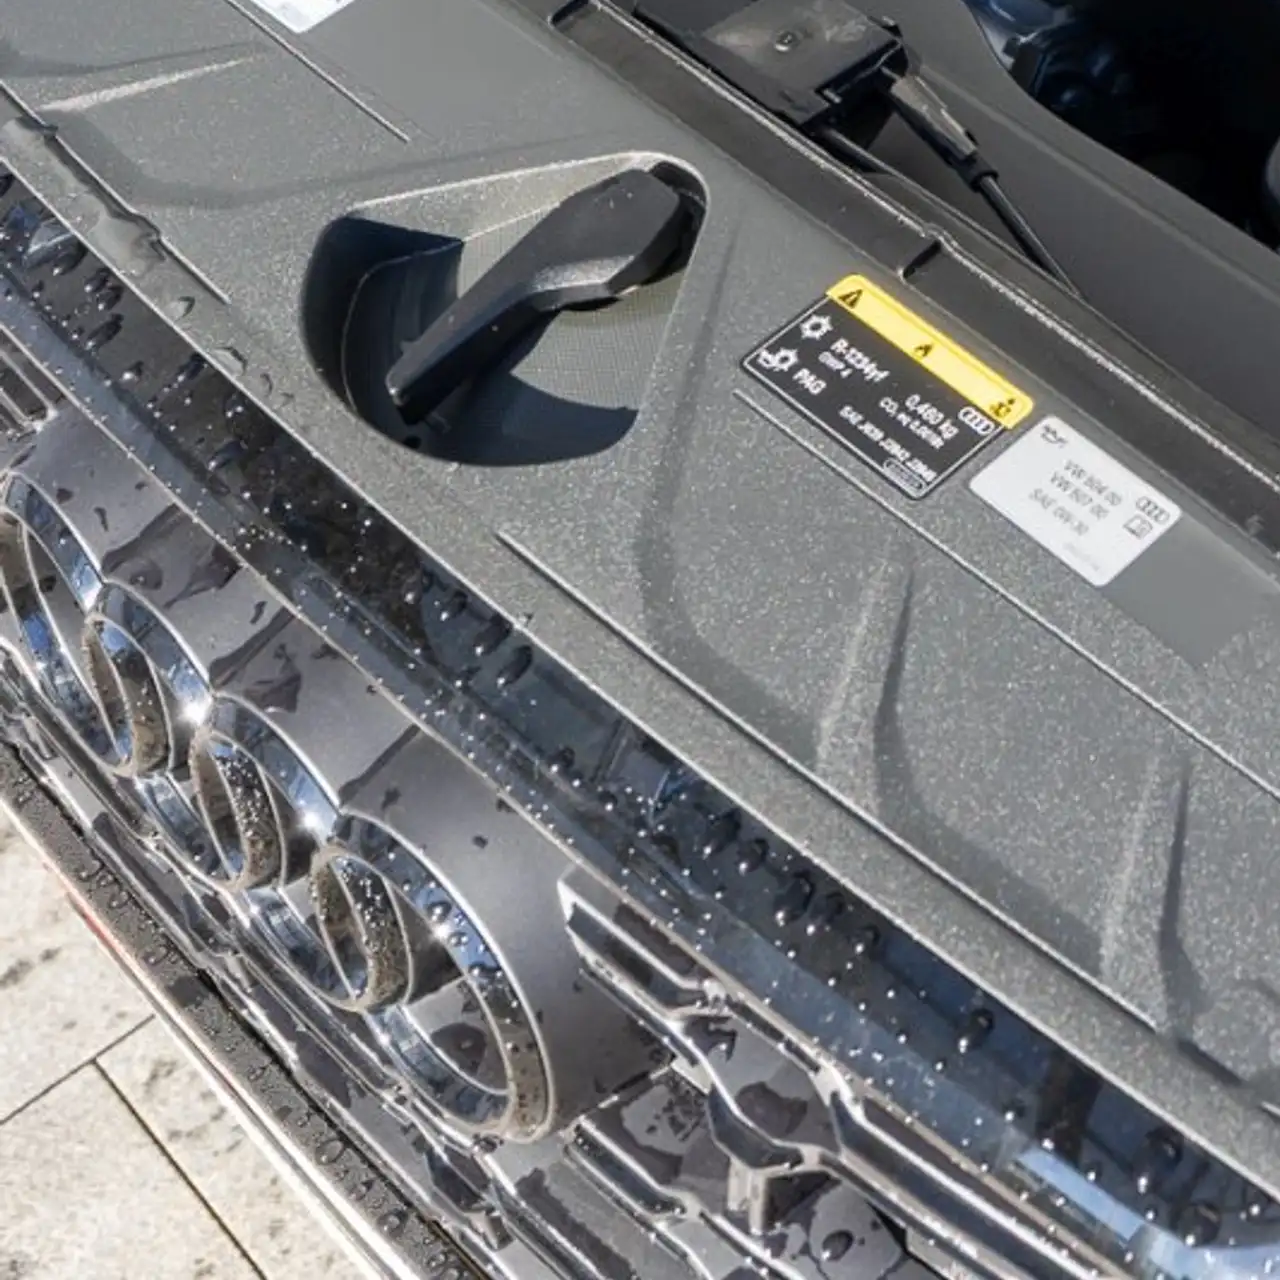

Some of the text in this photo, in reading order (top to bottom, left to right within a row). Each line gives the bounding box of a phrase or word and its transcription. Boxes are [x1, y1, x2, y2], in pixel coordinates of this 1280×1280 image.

[793, 369, 826, 394] PAG
[937, 419, 959, 439] kg
[1064, 461, 1085, 479] VW
[1051, 472, 1071, 492] VW
